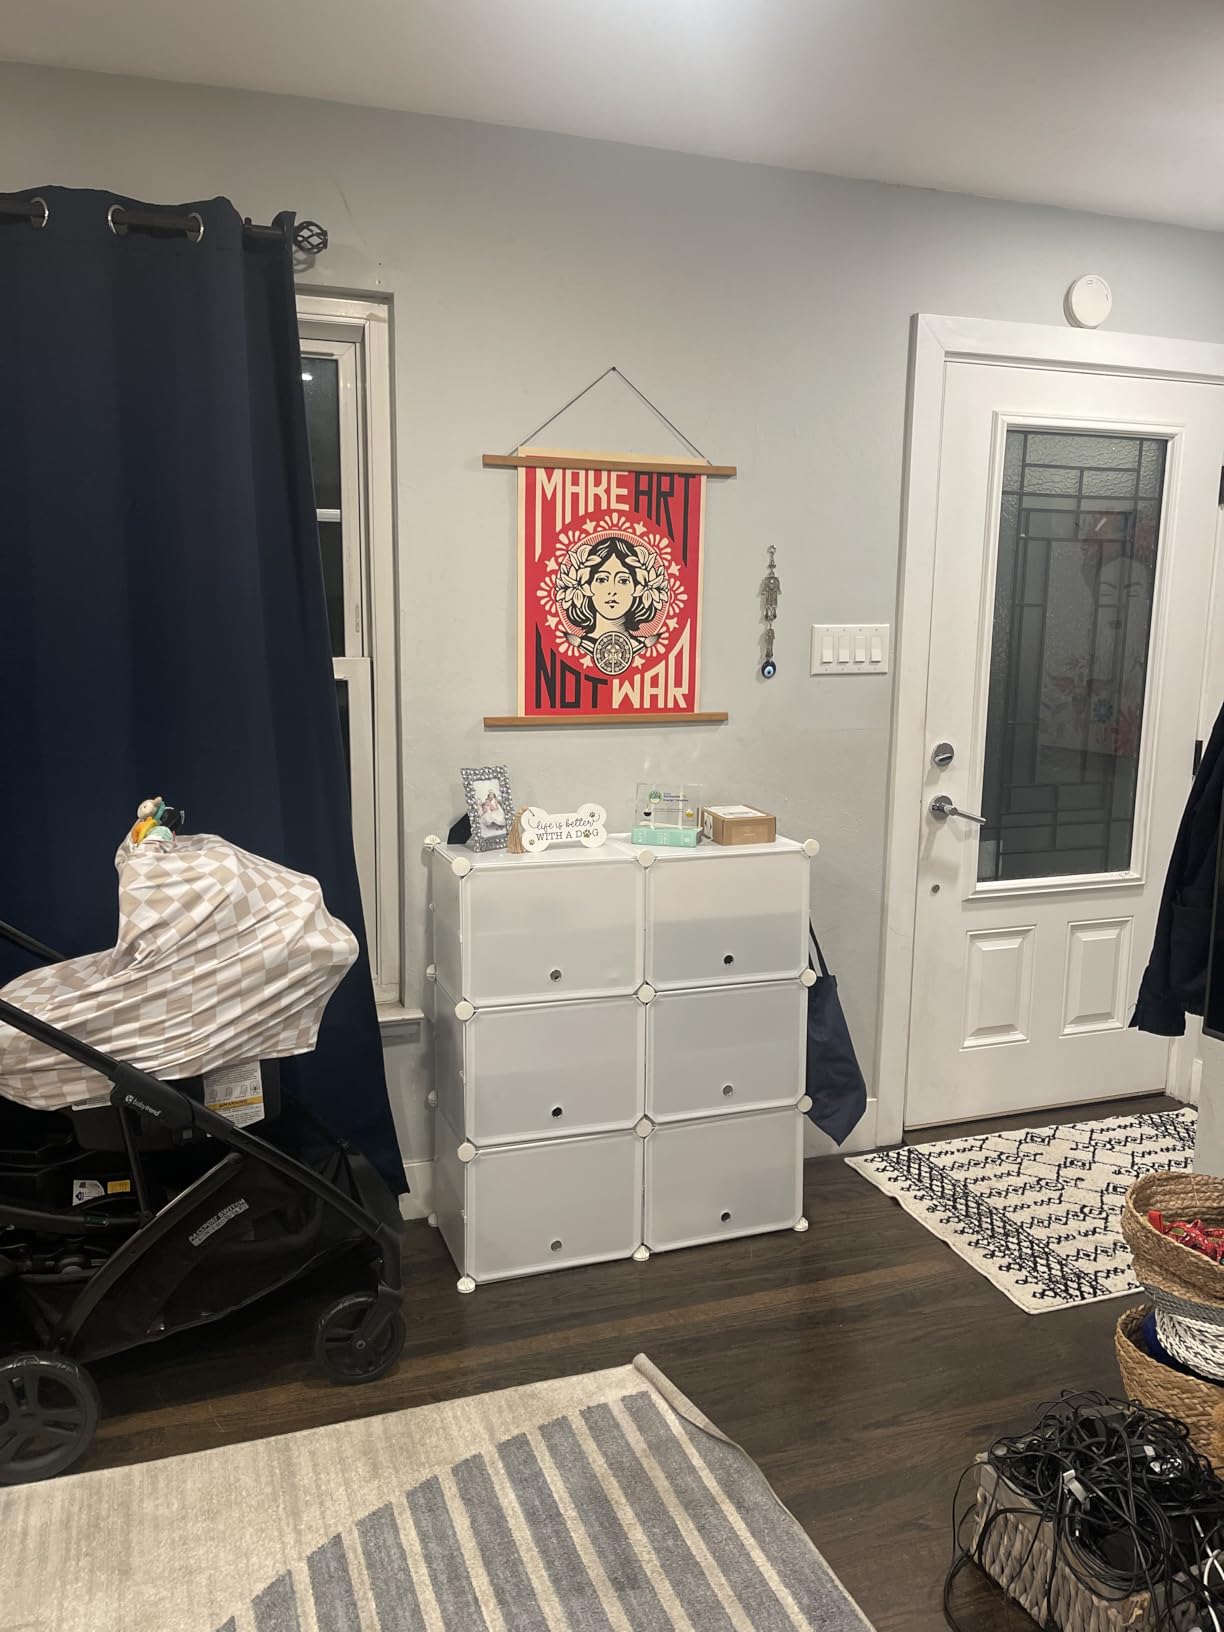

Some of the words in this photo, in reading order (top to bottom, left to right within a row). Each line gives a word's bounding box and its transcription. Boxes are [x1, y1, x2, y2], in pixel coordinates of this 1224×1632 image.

[535, 468, 629, 563] MAKE
[633, 471, 695, 568] ART
[535, 621, 608, 709] NOT
[611, 618, 690, 709] WAR
[531, 820, 554, 833] life
[555, 821, 563, 829] is
[565, 817, 597, 828] better
[536, 831, 563, 841] WITH
[565, 831, 573, 840] A
